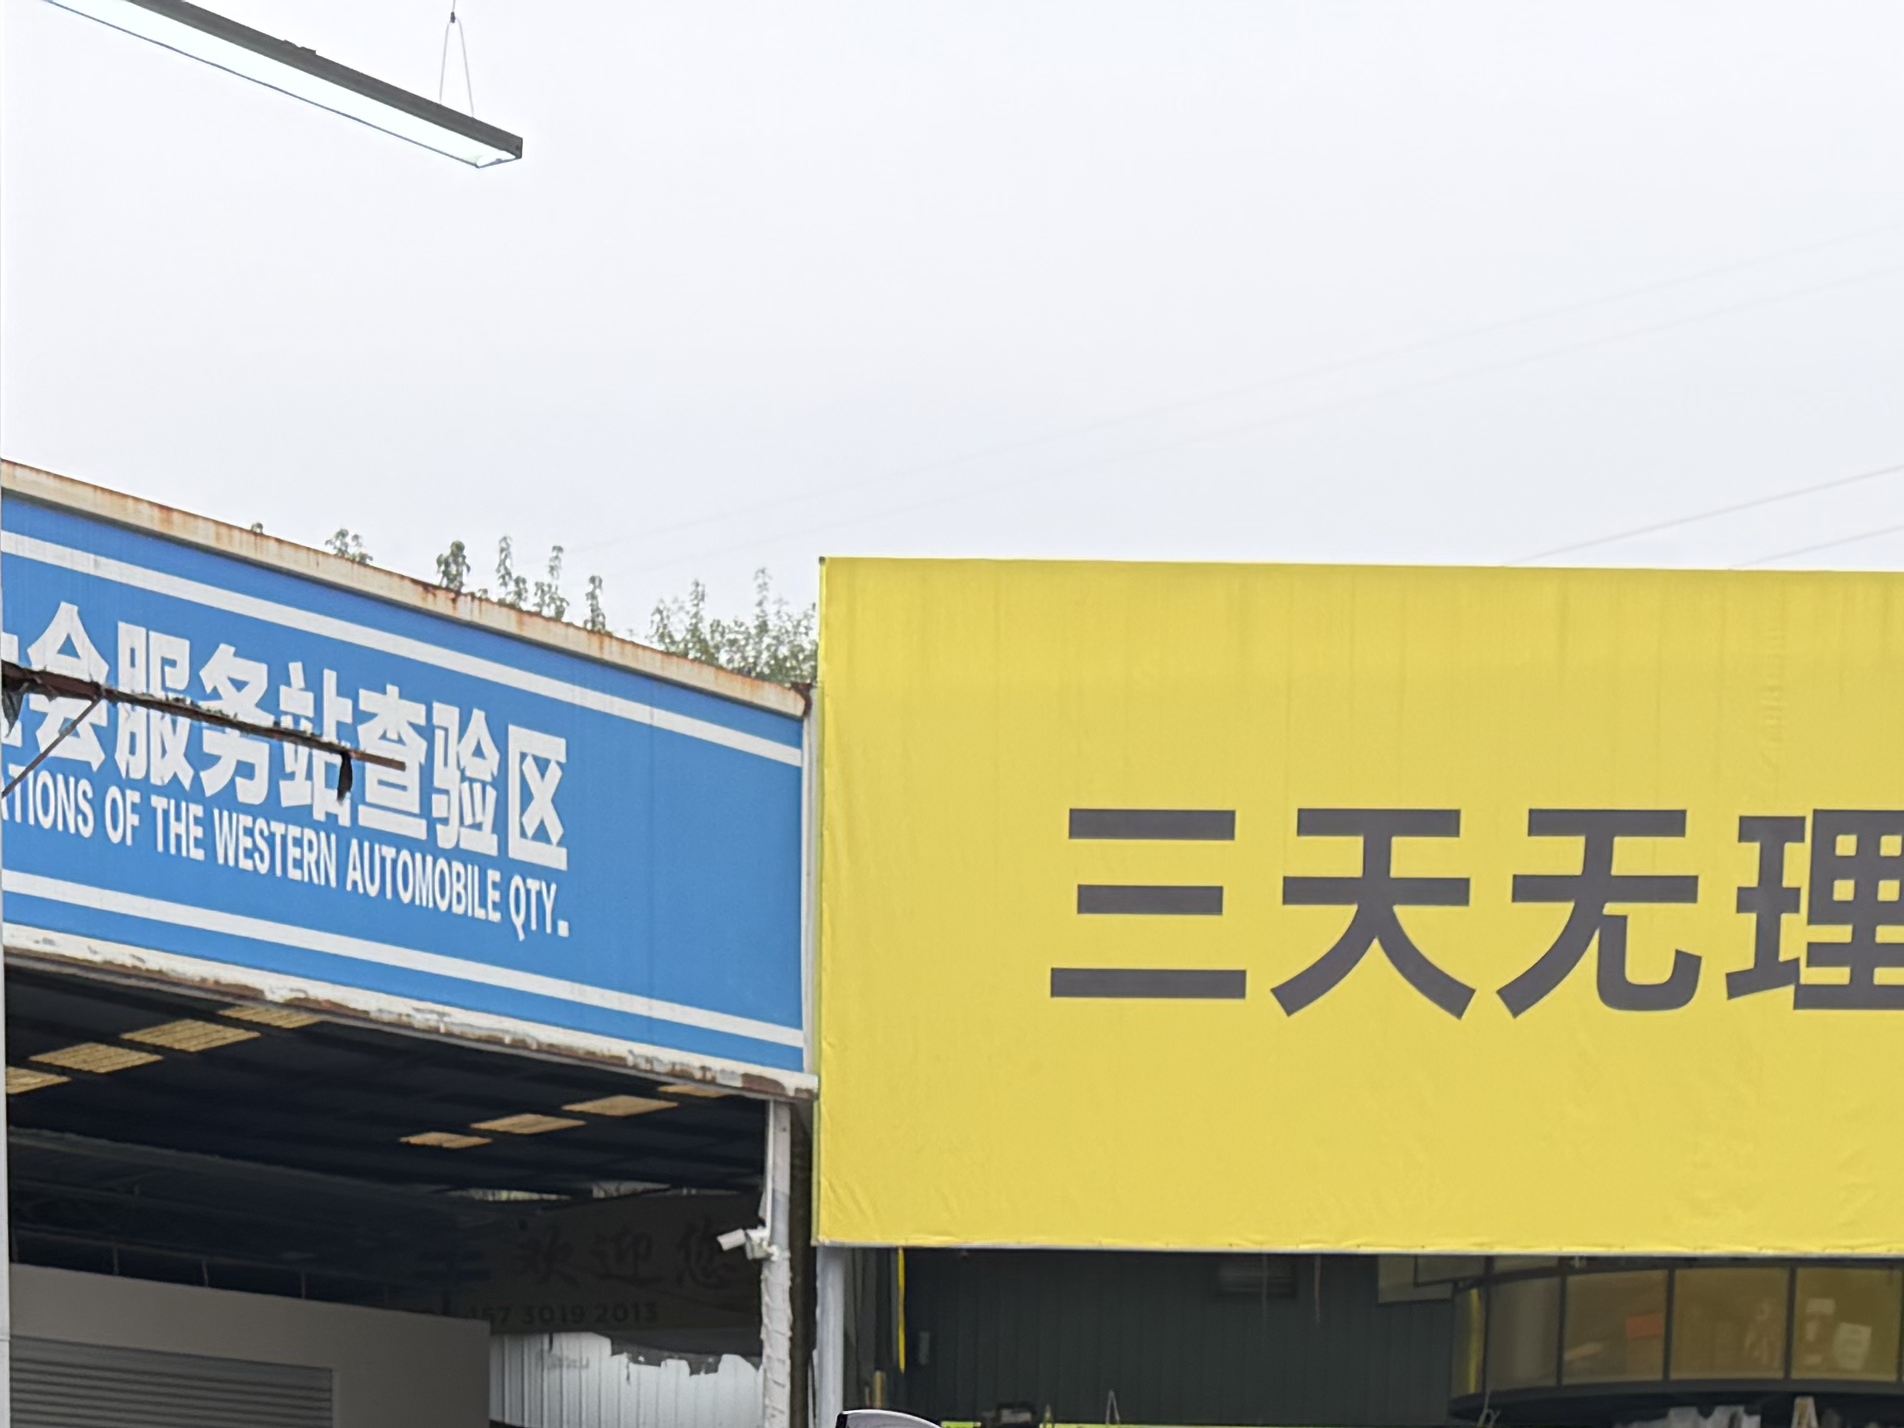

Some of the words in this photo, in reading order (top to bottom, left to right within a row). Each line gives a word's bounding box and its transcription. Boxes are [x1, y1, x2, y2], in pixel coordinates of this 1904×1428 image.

[104, 783, 141, 847] OF
[151, 797, 205, 861] THE
[214, 810, 337, 888] WESTERN
[346, 839, 502, 923] AUTOMOBILE
[509, 876, 571, 942] QTY.
[521, 1303, 586, 1326] 3019
[593, 1301, 658, 1324] 2013
